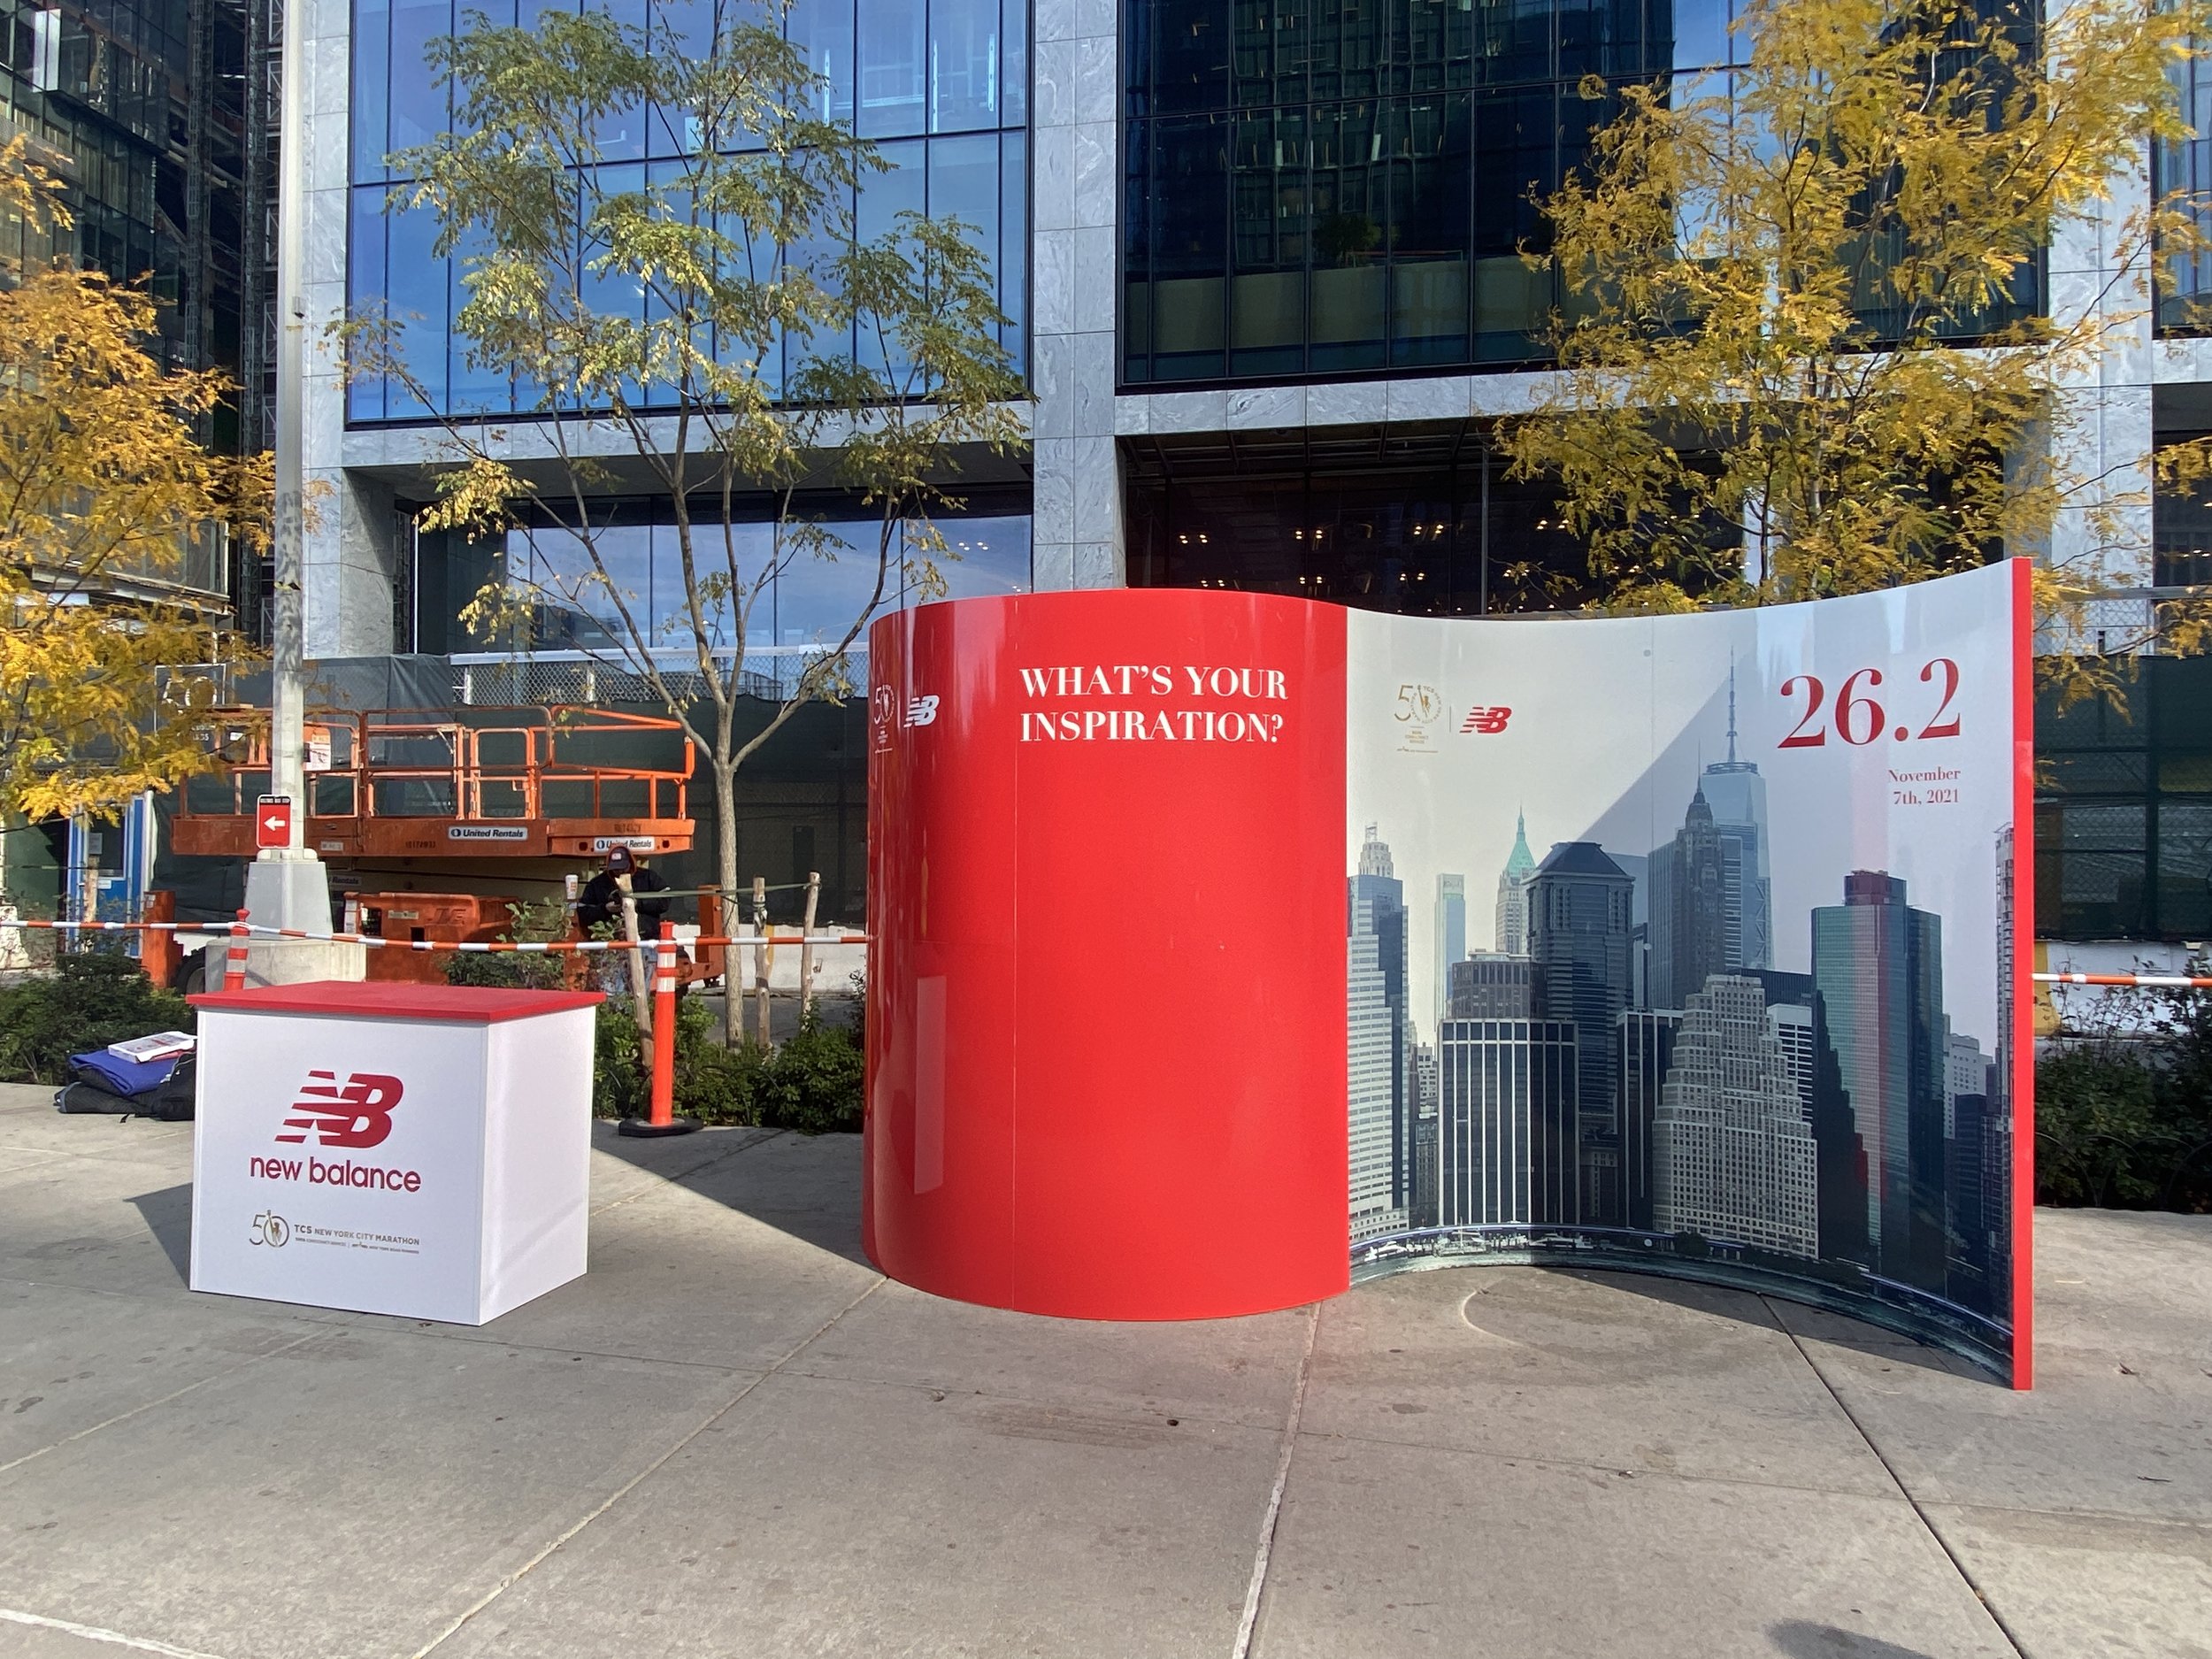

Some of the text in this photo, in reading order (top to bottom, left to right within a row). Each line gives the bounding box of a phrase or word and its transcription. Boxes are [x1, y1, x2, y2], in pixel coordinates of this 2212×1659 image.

[1019, 664, 1289, 700] WHAT'S YOUR
[1778, 657, 1961, 749] 26.2
[1019, 710, 1283, 743] INSPIRATION?
[1459, 707, 1512, 733] NB
[1887, 766, 1962, 783] November
[1893, 788, 1959, 806] 7th, 2021
[463, 828, 524, 838] United Rentals
[274, 1070, 404, 1148] NB
[250, 1156, 421, 1193] new balance
[294, 1224, 312, 1234] TCS
[334, 1230, 355, 1239] YORK
[356, 1232, 374, 1240] CITY
[375, 1234, 420, 1246] MARATHON
